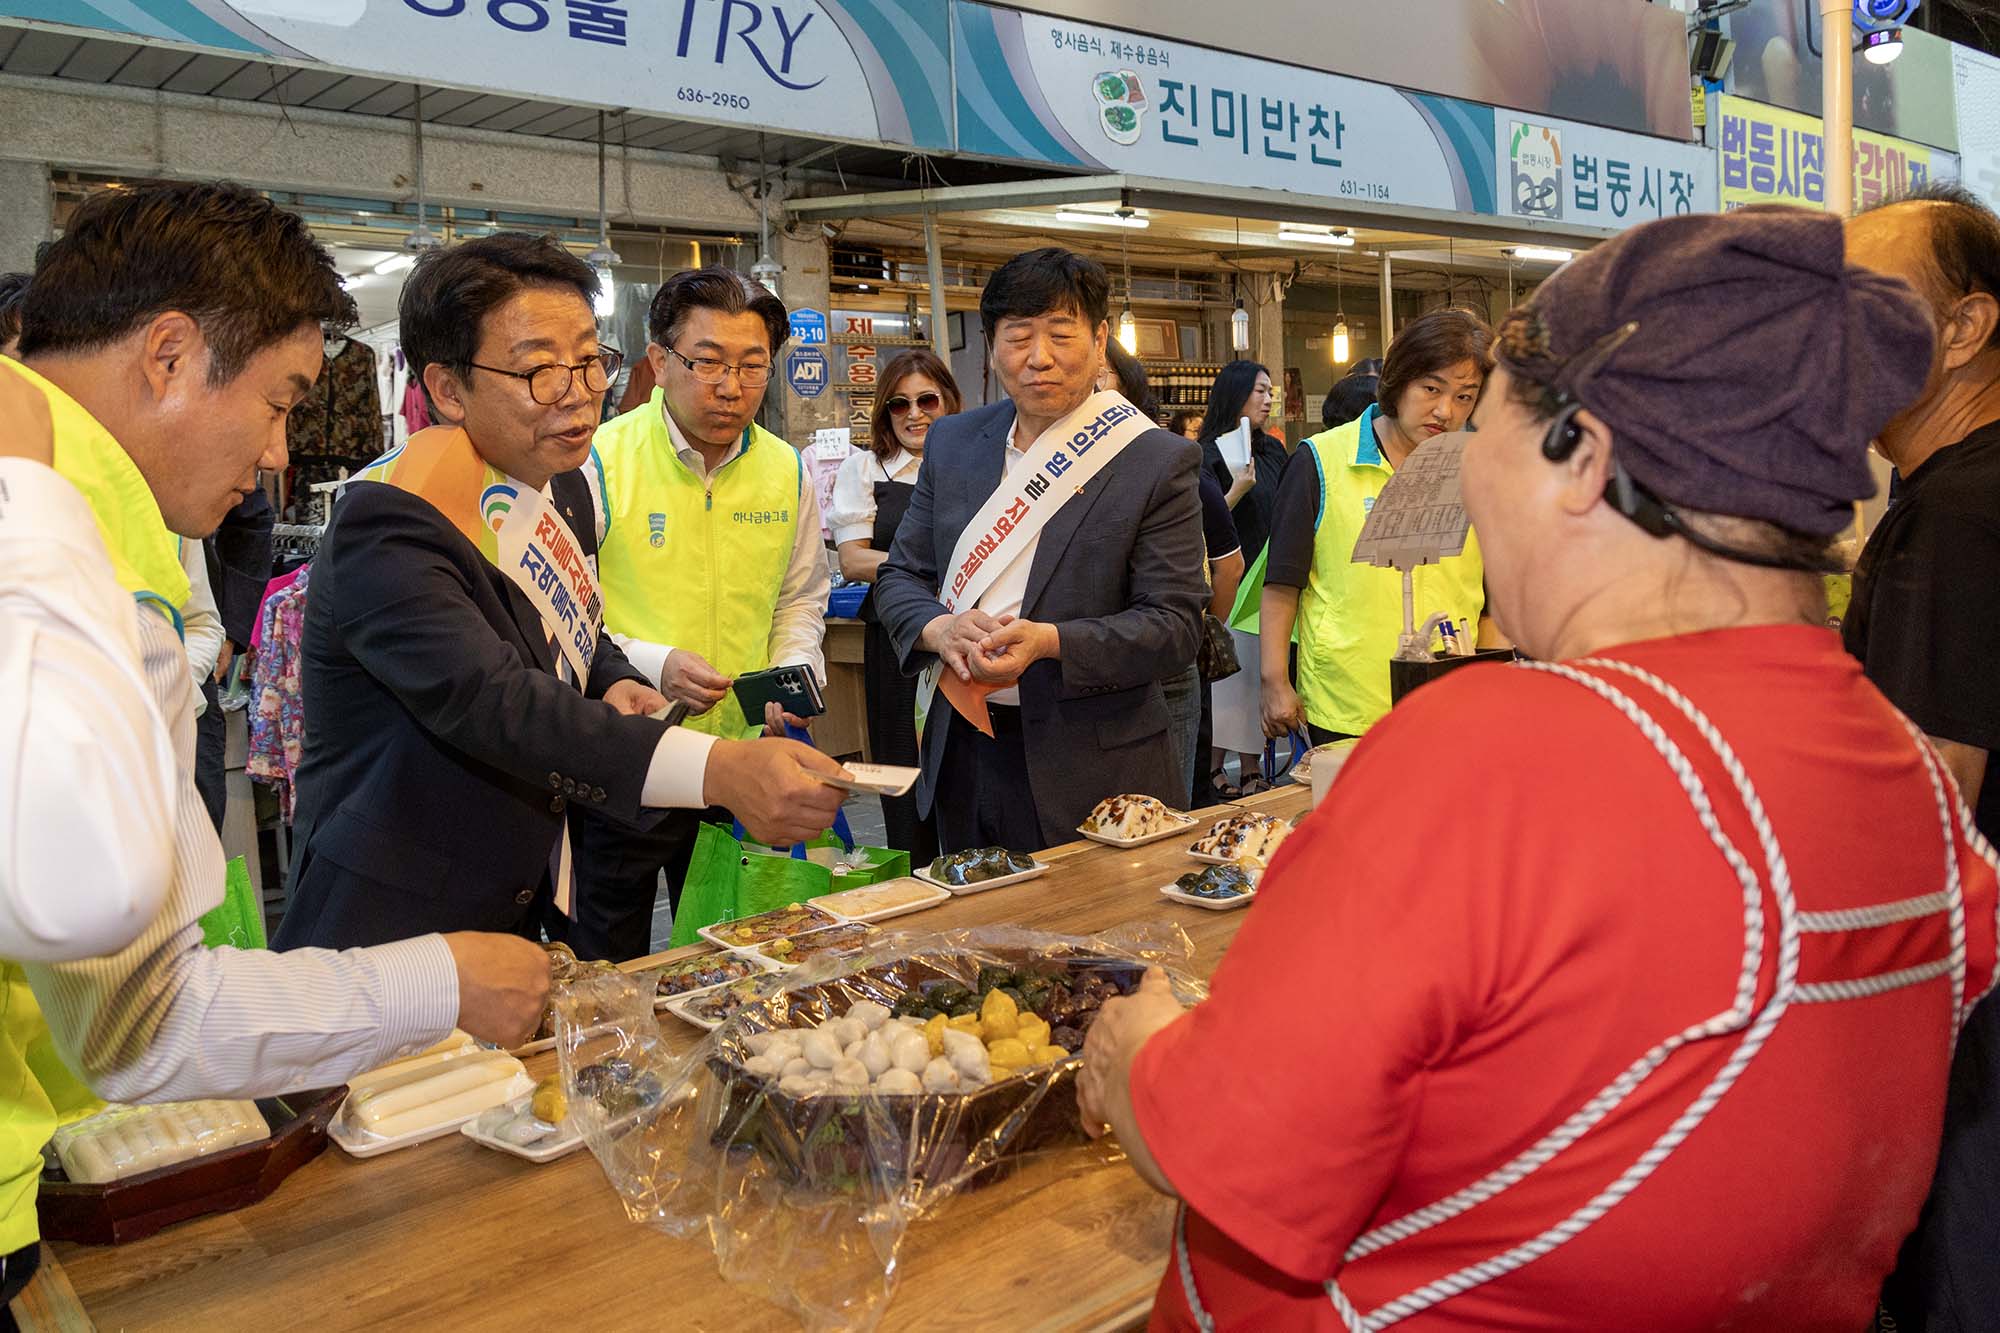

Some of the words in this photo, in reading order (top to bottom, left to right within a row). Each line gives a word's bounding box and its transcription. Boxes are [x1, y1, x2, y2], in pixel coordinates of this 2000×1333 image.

[1051, 28, 1106, 57] 행사음식,
[1110, 39, 1170, 69] 제수용음식
[676, 87, 750, 110] 636-2950
[1158, 78, 1346, 168] 진미반찬
[1522, 153, 1552, 169] 법동시장
[1723, 115, 1824, 203] 법동시장
[1340, 179, 1390, 200] 631-1154
[1572, 153, 1695, 219] 법동시장
[793, 326, 824, 341] 23-10
[794, 362, 823, 381] ADT
[1066, 403, 1138, 457] 소비자의
[1045, 450, 1074, 479] 힘
[1024, 472, 1051, 501] 곧
[733, 510, 790, 524] 하나금융그룹
[951, 496, 1031, 599] 지역경제의
[520, 542, 579, 634] 지역물가
